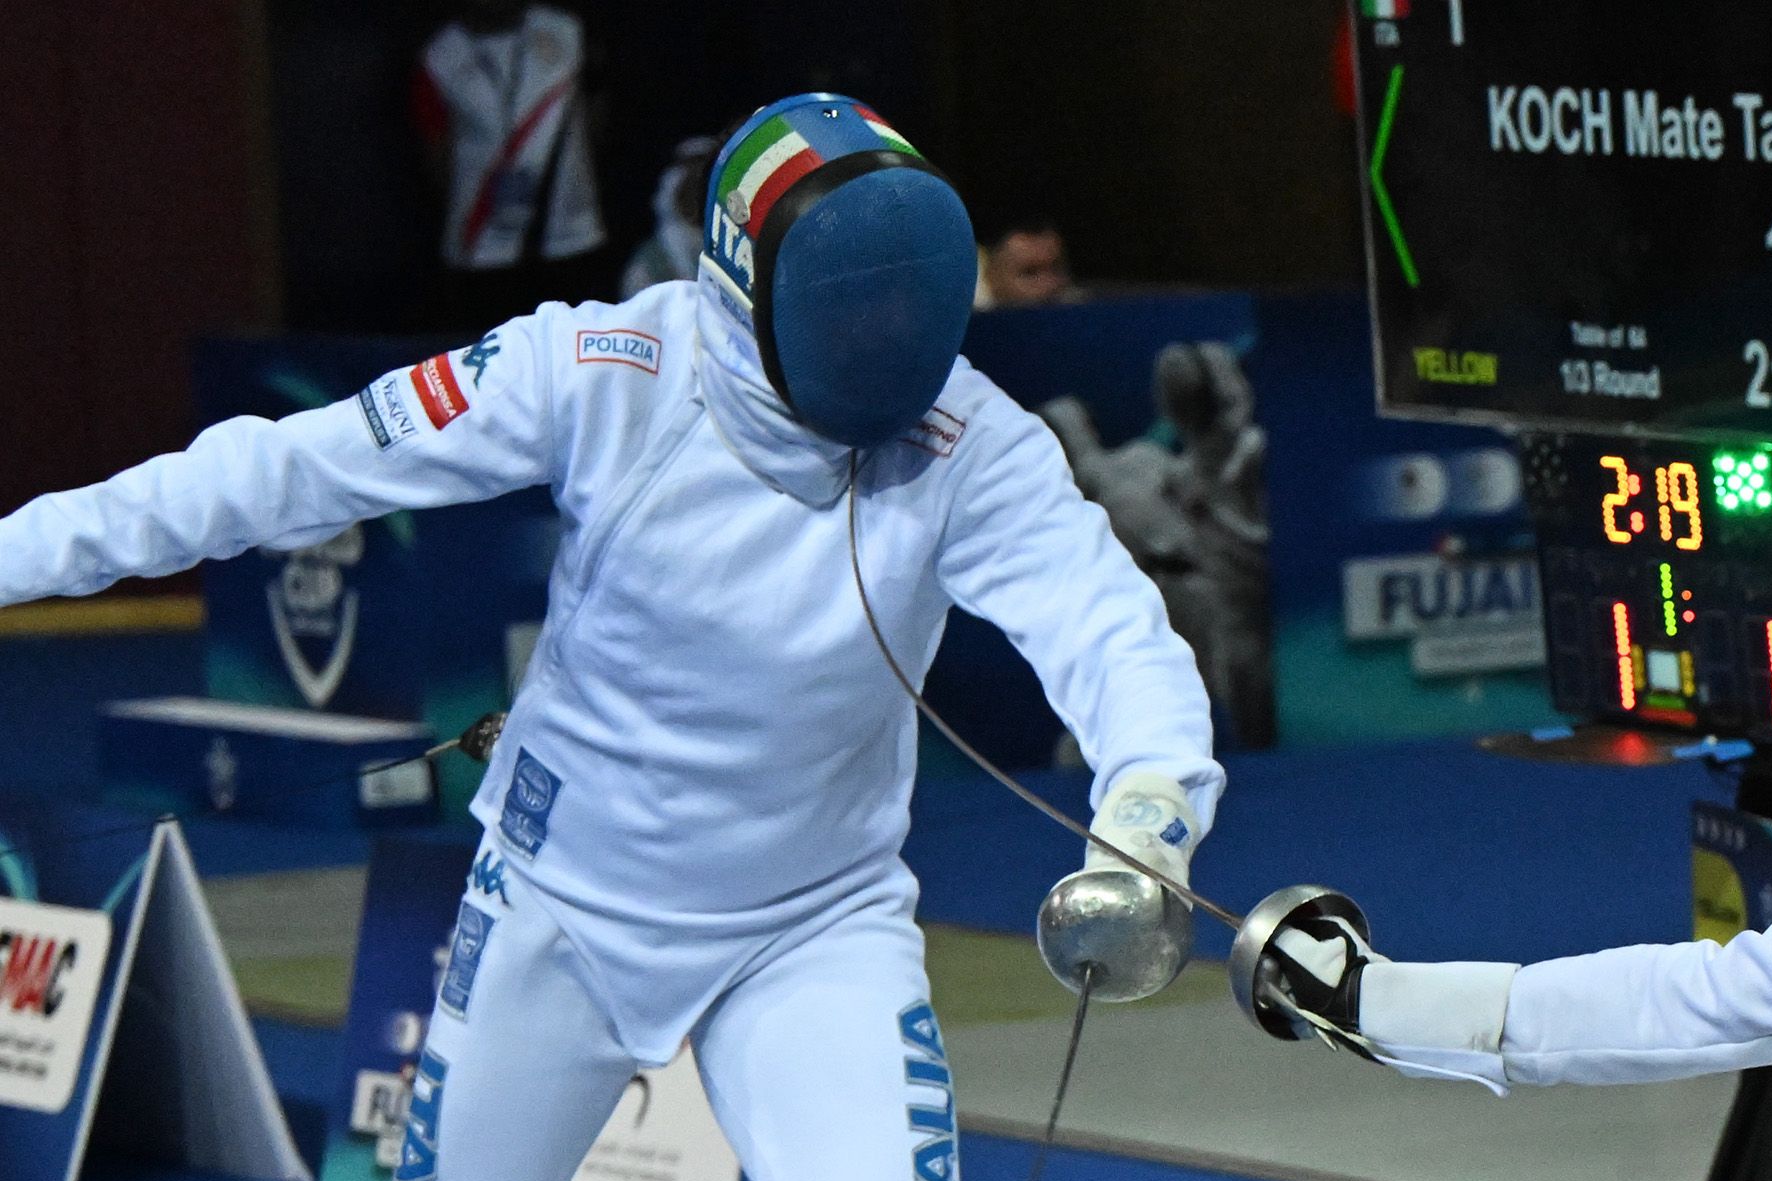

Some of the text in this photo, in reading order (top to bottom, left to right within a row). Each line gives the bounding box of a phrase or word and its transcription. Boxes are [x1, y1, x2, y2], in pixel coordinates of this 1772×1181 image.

[1488, 86, 1613, 155] KOCH
[1624, 89, 1725, 160] Mate
[582, 336, 654, 363] POLIZIA
[1413, 346, 1498, 385] YELLOW
[1559, 359, 1661, 400] 1/3 Round
[1600, 455, 1703, 551] 2:19
[1378, 562, 1540, 621] FUJAI
[1613, 602, 1636, 710] 1
